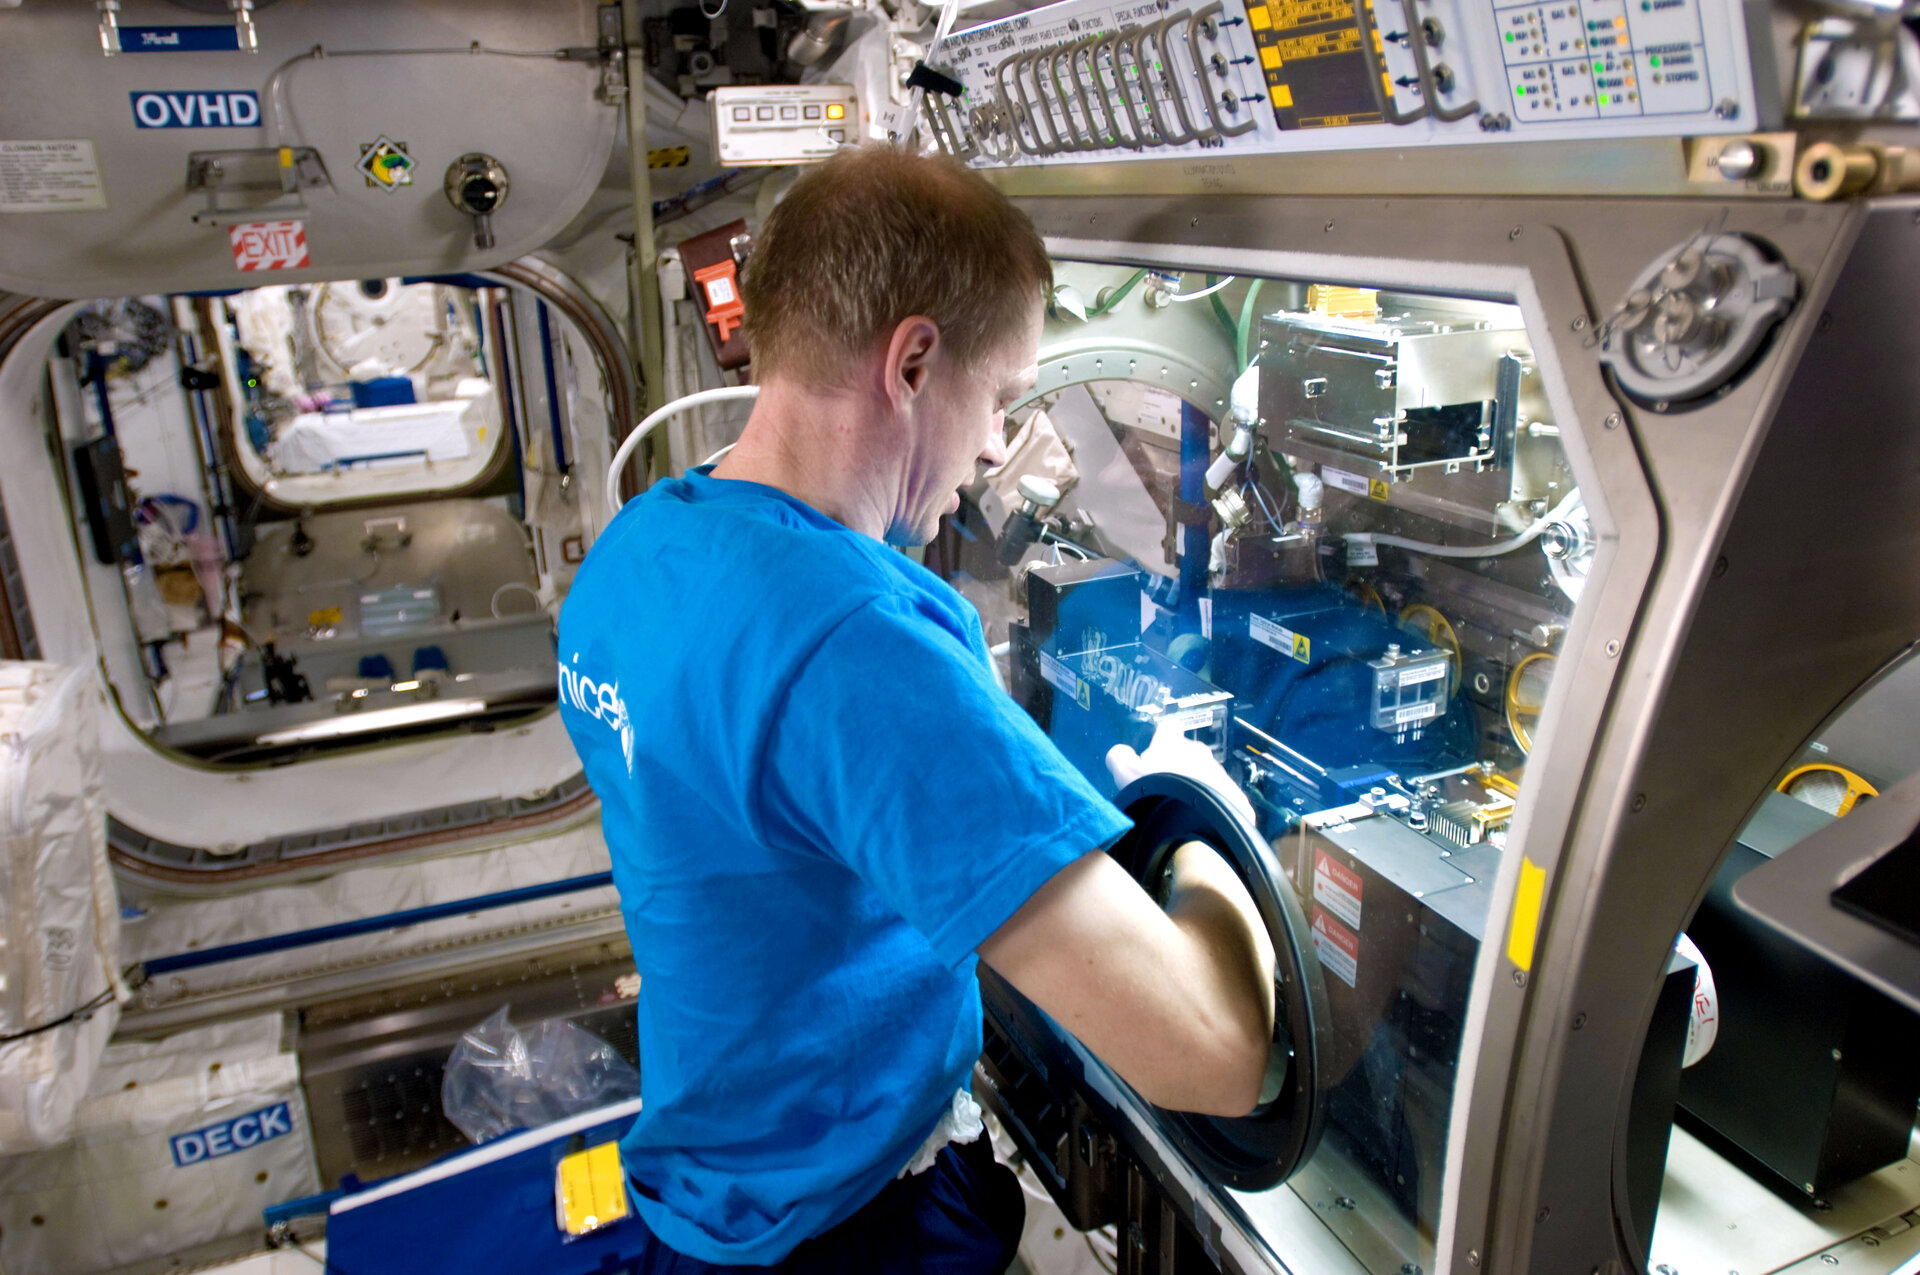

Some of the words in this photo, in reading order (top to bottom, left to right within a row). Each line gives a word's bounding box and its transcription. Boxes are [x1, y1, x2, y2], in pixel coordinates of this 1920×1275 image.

[1133, 3, 1158, 18] FUNCTIONS
[994, 22, 1014, 36] PANEL
[1645, 42, 1692, 55] PROCESSORS
[1665, 71, 1699, 82] STOPPED
[136, 94, 259, 127] OVHD
[242, 229, 294, 258] EXIT
[1332, 867, 1360, 891] DANGER
[1328, 925, 1354, 950] DANGER
[175, 1105, 289, 1164] DECK
